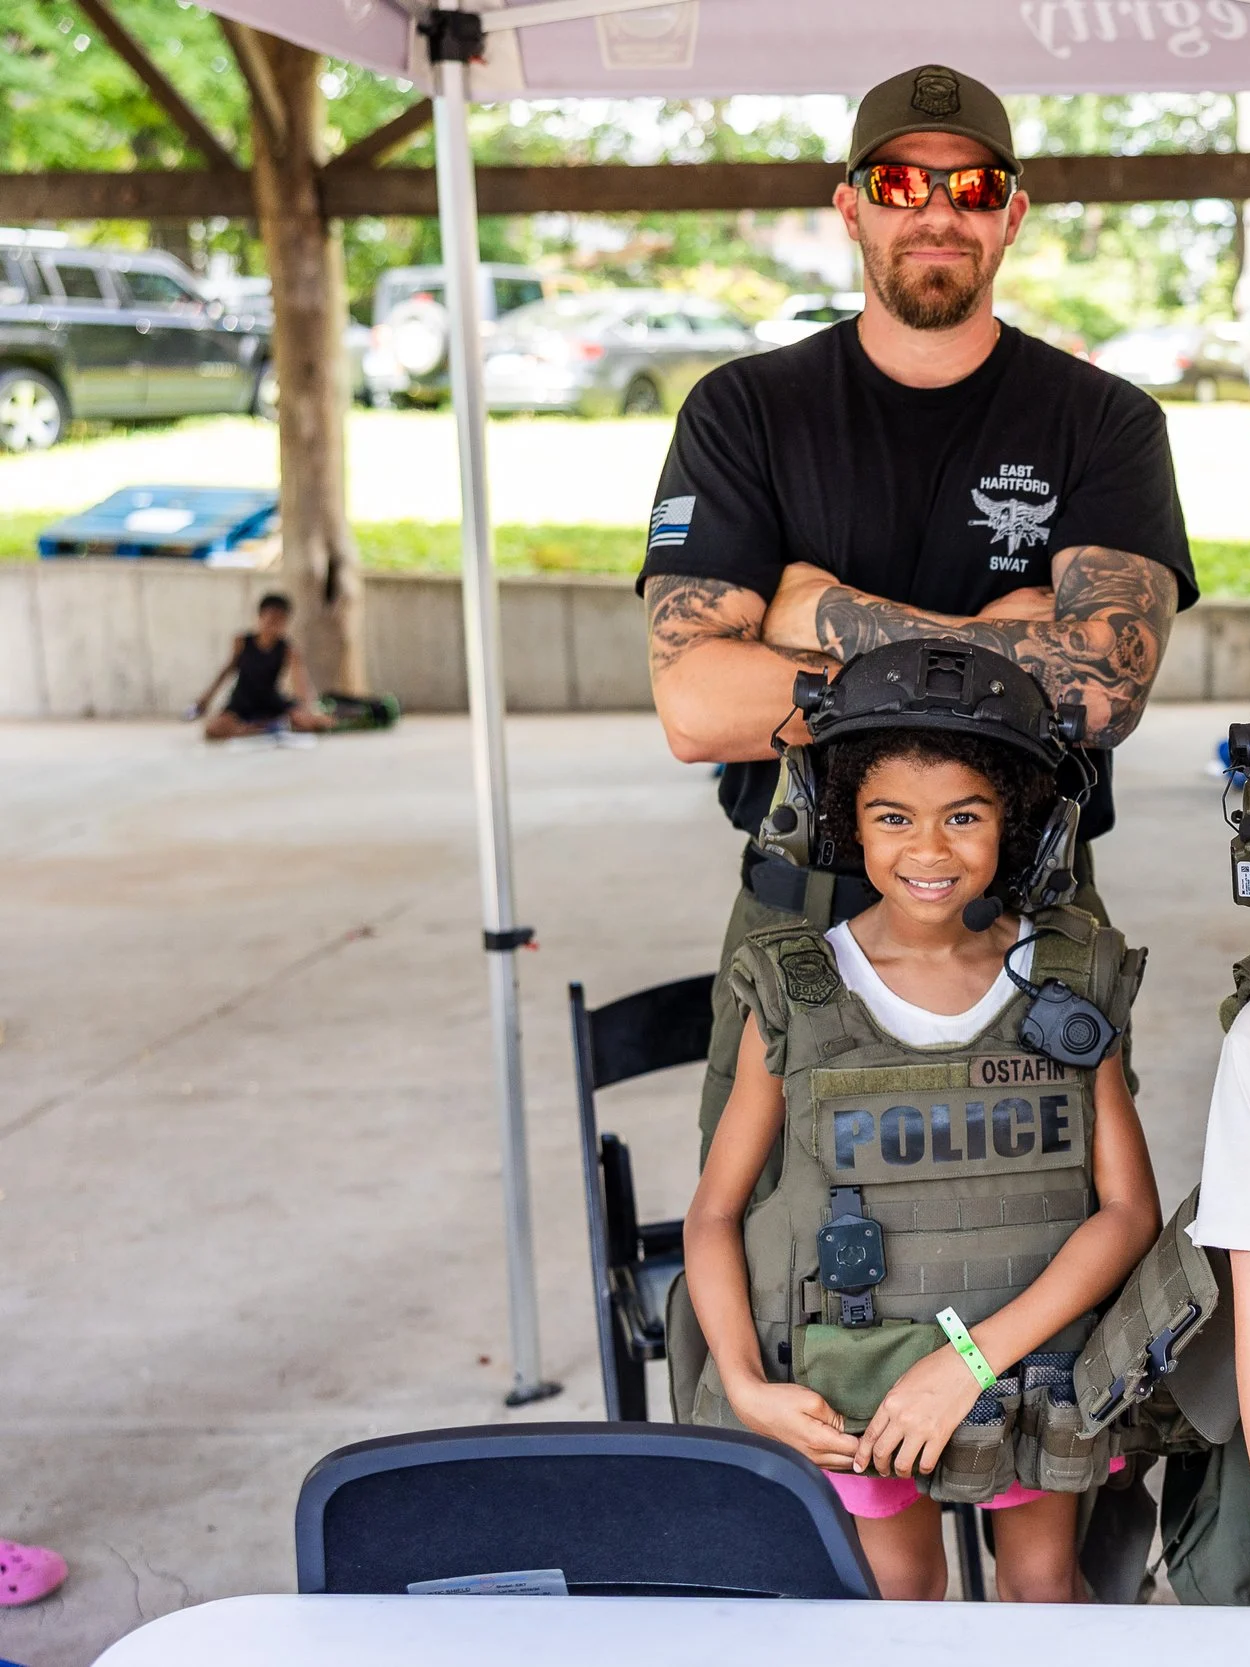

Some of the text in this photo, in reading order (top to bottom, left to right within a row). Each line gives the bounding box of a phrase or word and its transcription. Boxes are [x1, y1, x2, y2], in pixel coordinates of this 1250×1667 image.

[1000, 464, 1034, 478] EAST
[980, 477, 1050, 495] HARTFORD
[989, 556, 1029, 573] SWAT
[981, 1057, 1065, 1084] OSTAFIN
[833, 1094, 1072, 1171] POLICE
